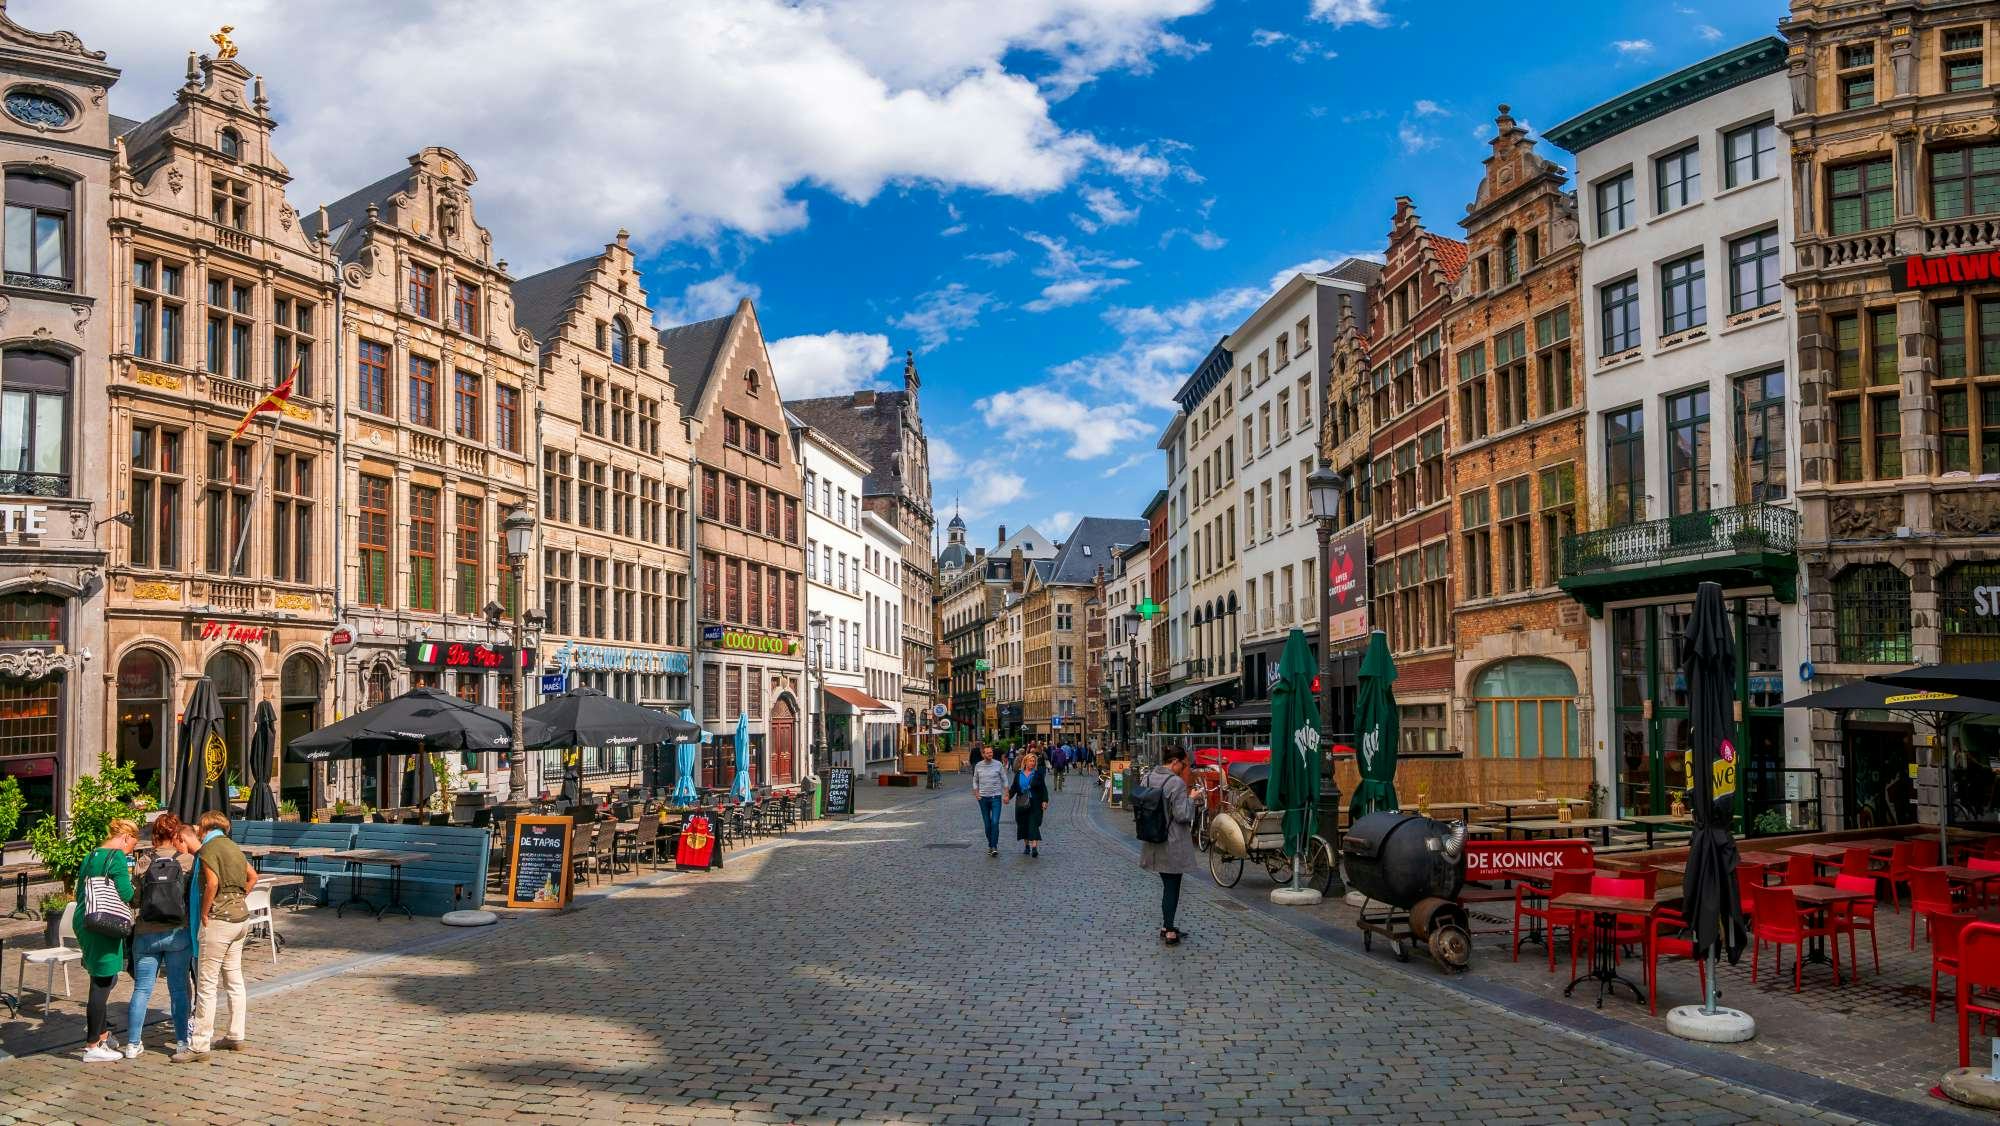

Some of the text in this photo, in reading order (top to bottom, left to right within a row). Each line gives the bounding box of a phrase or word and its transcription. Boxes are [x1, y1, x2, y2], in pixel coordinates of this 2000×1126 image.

[1973, 585, 2000, 616] ST
[726, 631, 783, 653] COCO LOCO
[577, 645, 626, 670] SEGWAY
[520, 837, 560, 848] DE TAPAS
[1467, 852, 1563, 868] DE KONINCK
